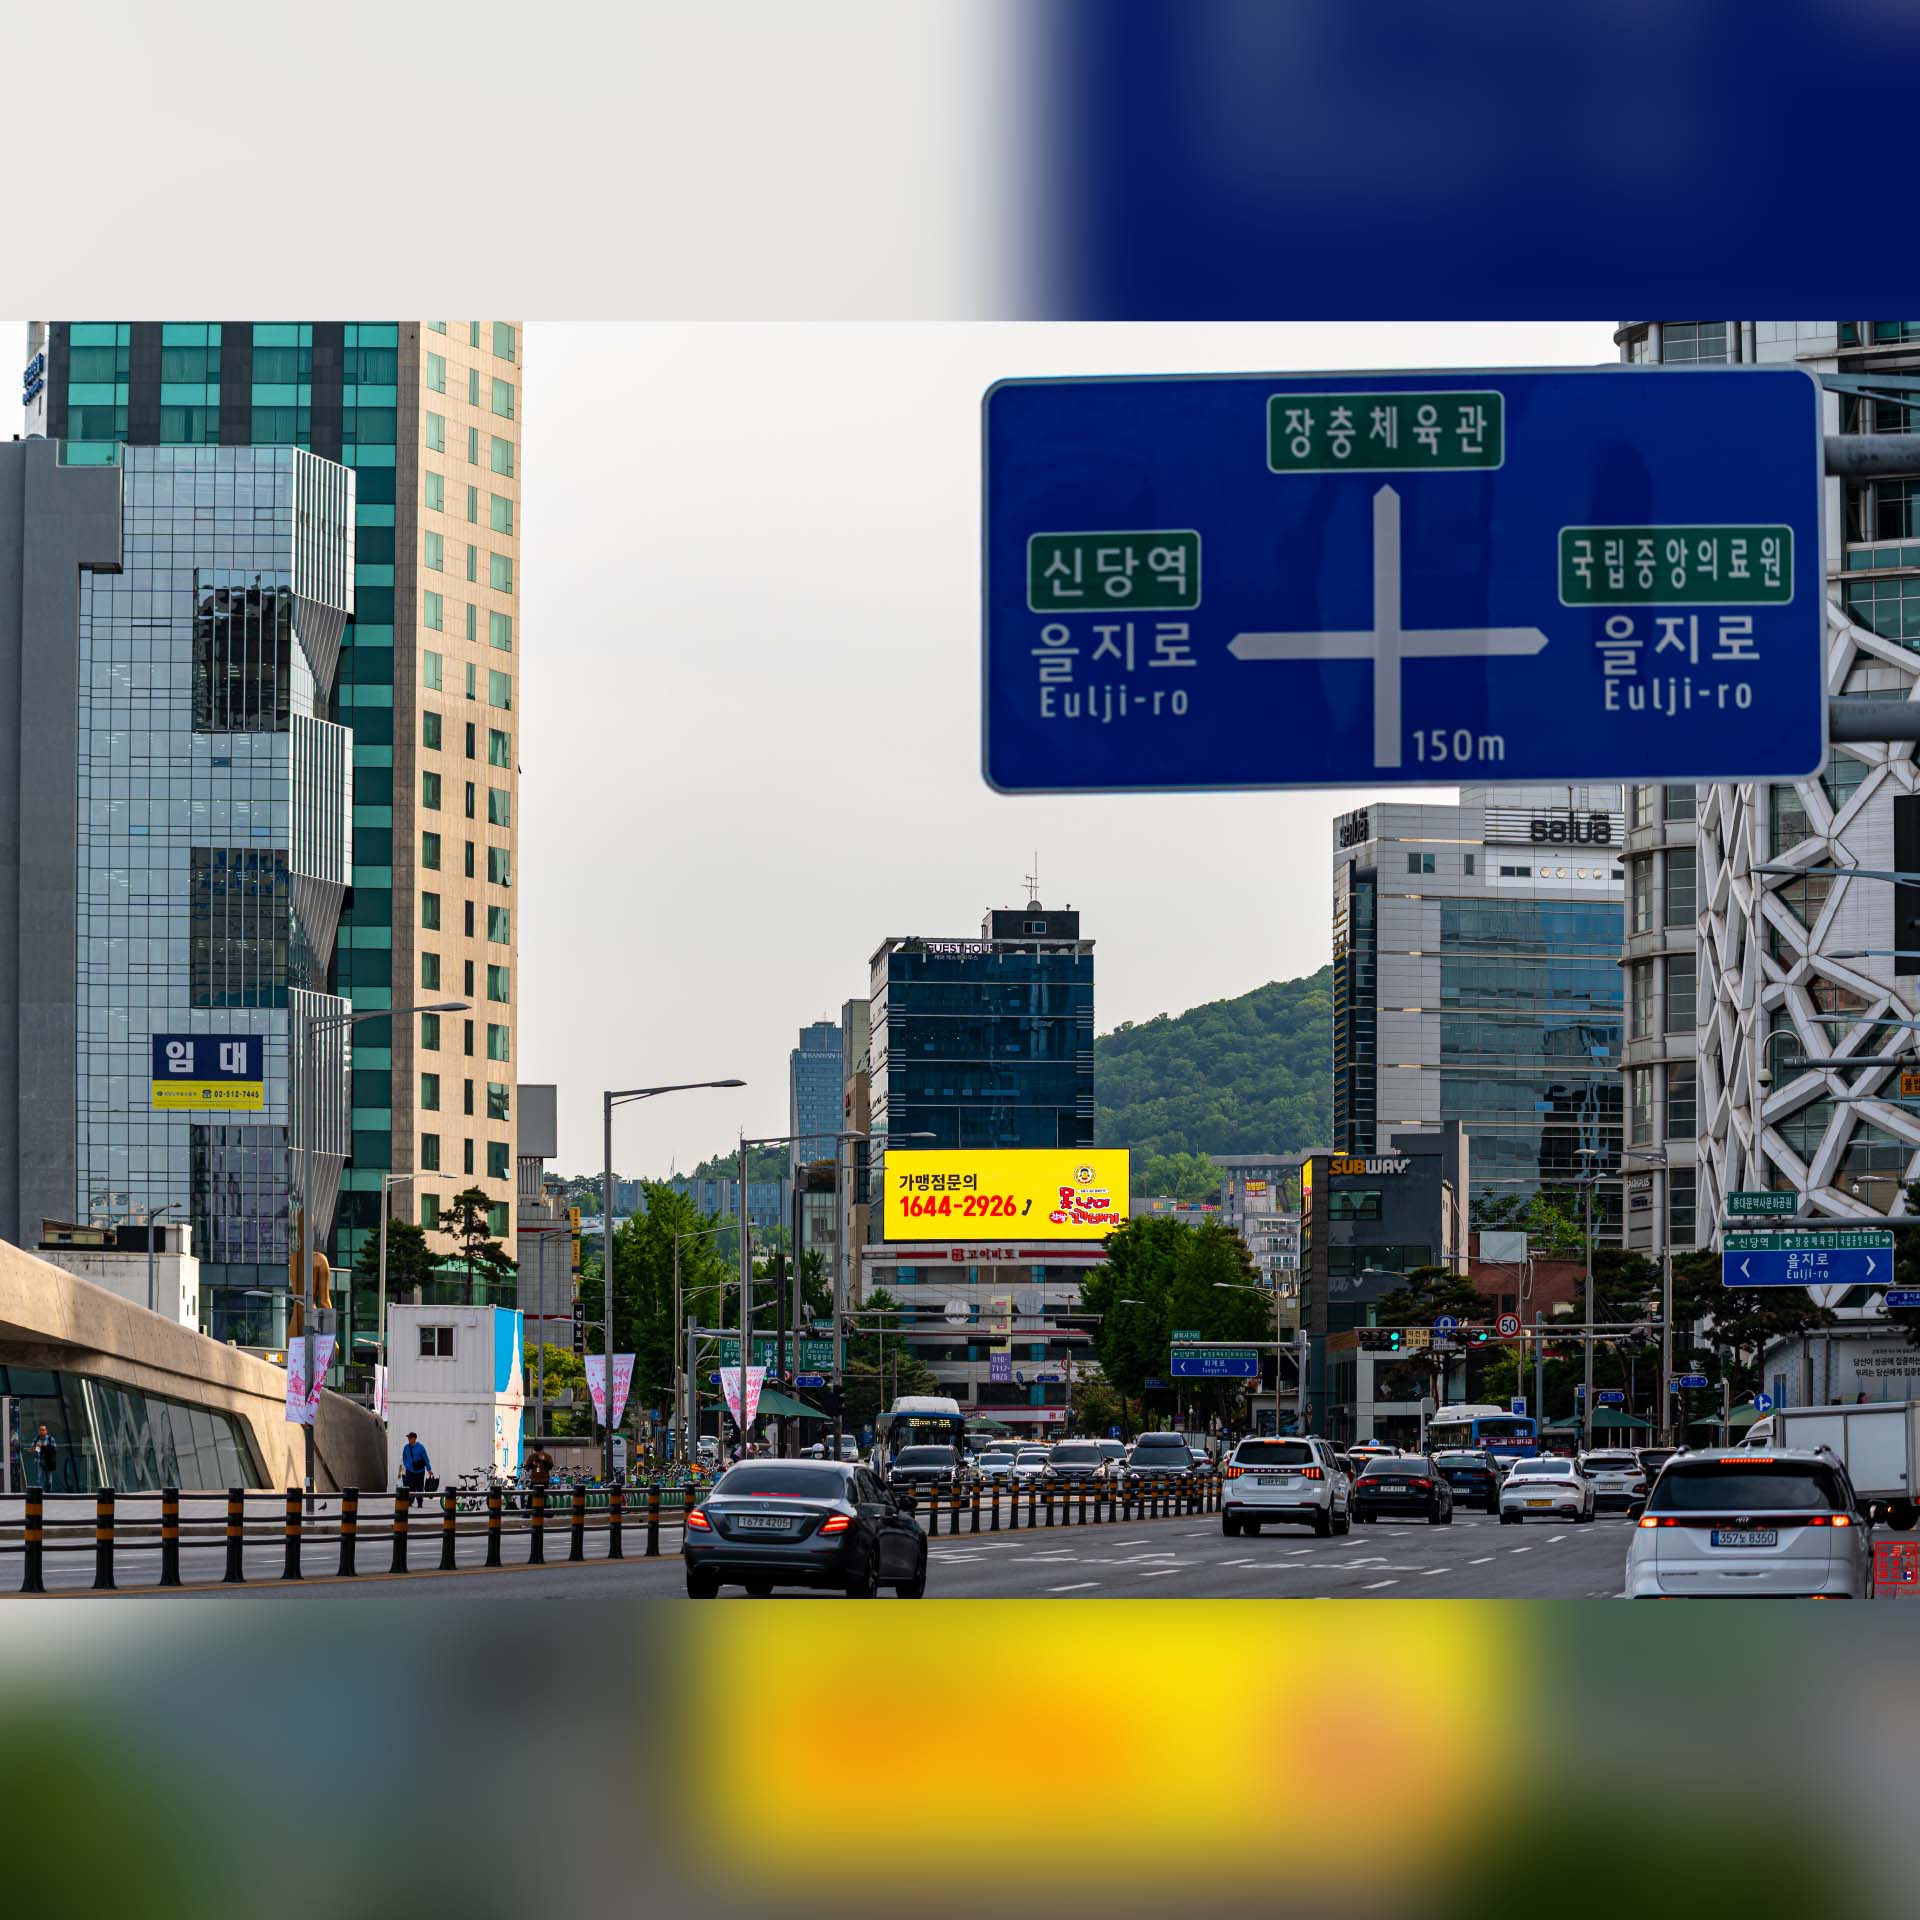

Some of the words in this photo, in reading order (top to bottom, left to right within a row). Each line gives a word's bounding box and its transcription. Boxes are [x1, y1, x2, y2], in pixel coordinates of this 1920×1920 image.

[1285, 405, 1487, 458] 장충체육관
[1044, 546, 1186, 597] 신당역
[1572, 538, 1781, 589] 국립중앙의료원
[1031, 622, 1197, 682] 을지로
[1595, 614, 1760, 676] 을지로
[1040, 684, 1188, 723] Eulji-ro
[1605, 677, 1752, 716] Eulji-ro
[1413, 729, 1505, 762] 150m
[1328, 1159, 1411, 1175] SUBWAY
[899, 1174, 977, 1191] 가맹점문의
[899, 1196, 1017, 1217] 1644-2926
[1733, 1197, 1792, 1209] 동대문역사문화공원
[1739, 1237, 1769, 1248] 신당역
[1795, 1236, 1834, 1247] 장충체육관
[1787, 1253, 1829, 1269] 을지로
[1787, 1269, 1829, 1280] Eulji-ro
[1501, 1320, 1516, 1332] 50
[1749, 1530, 1774, 1544] 8350
